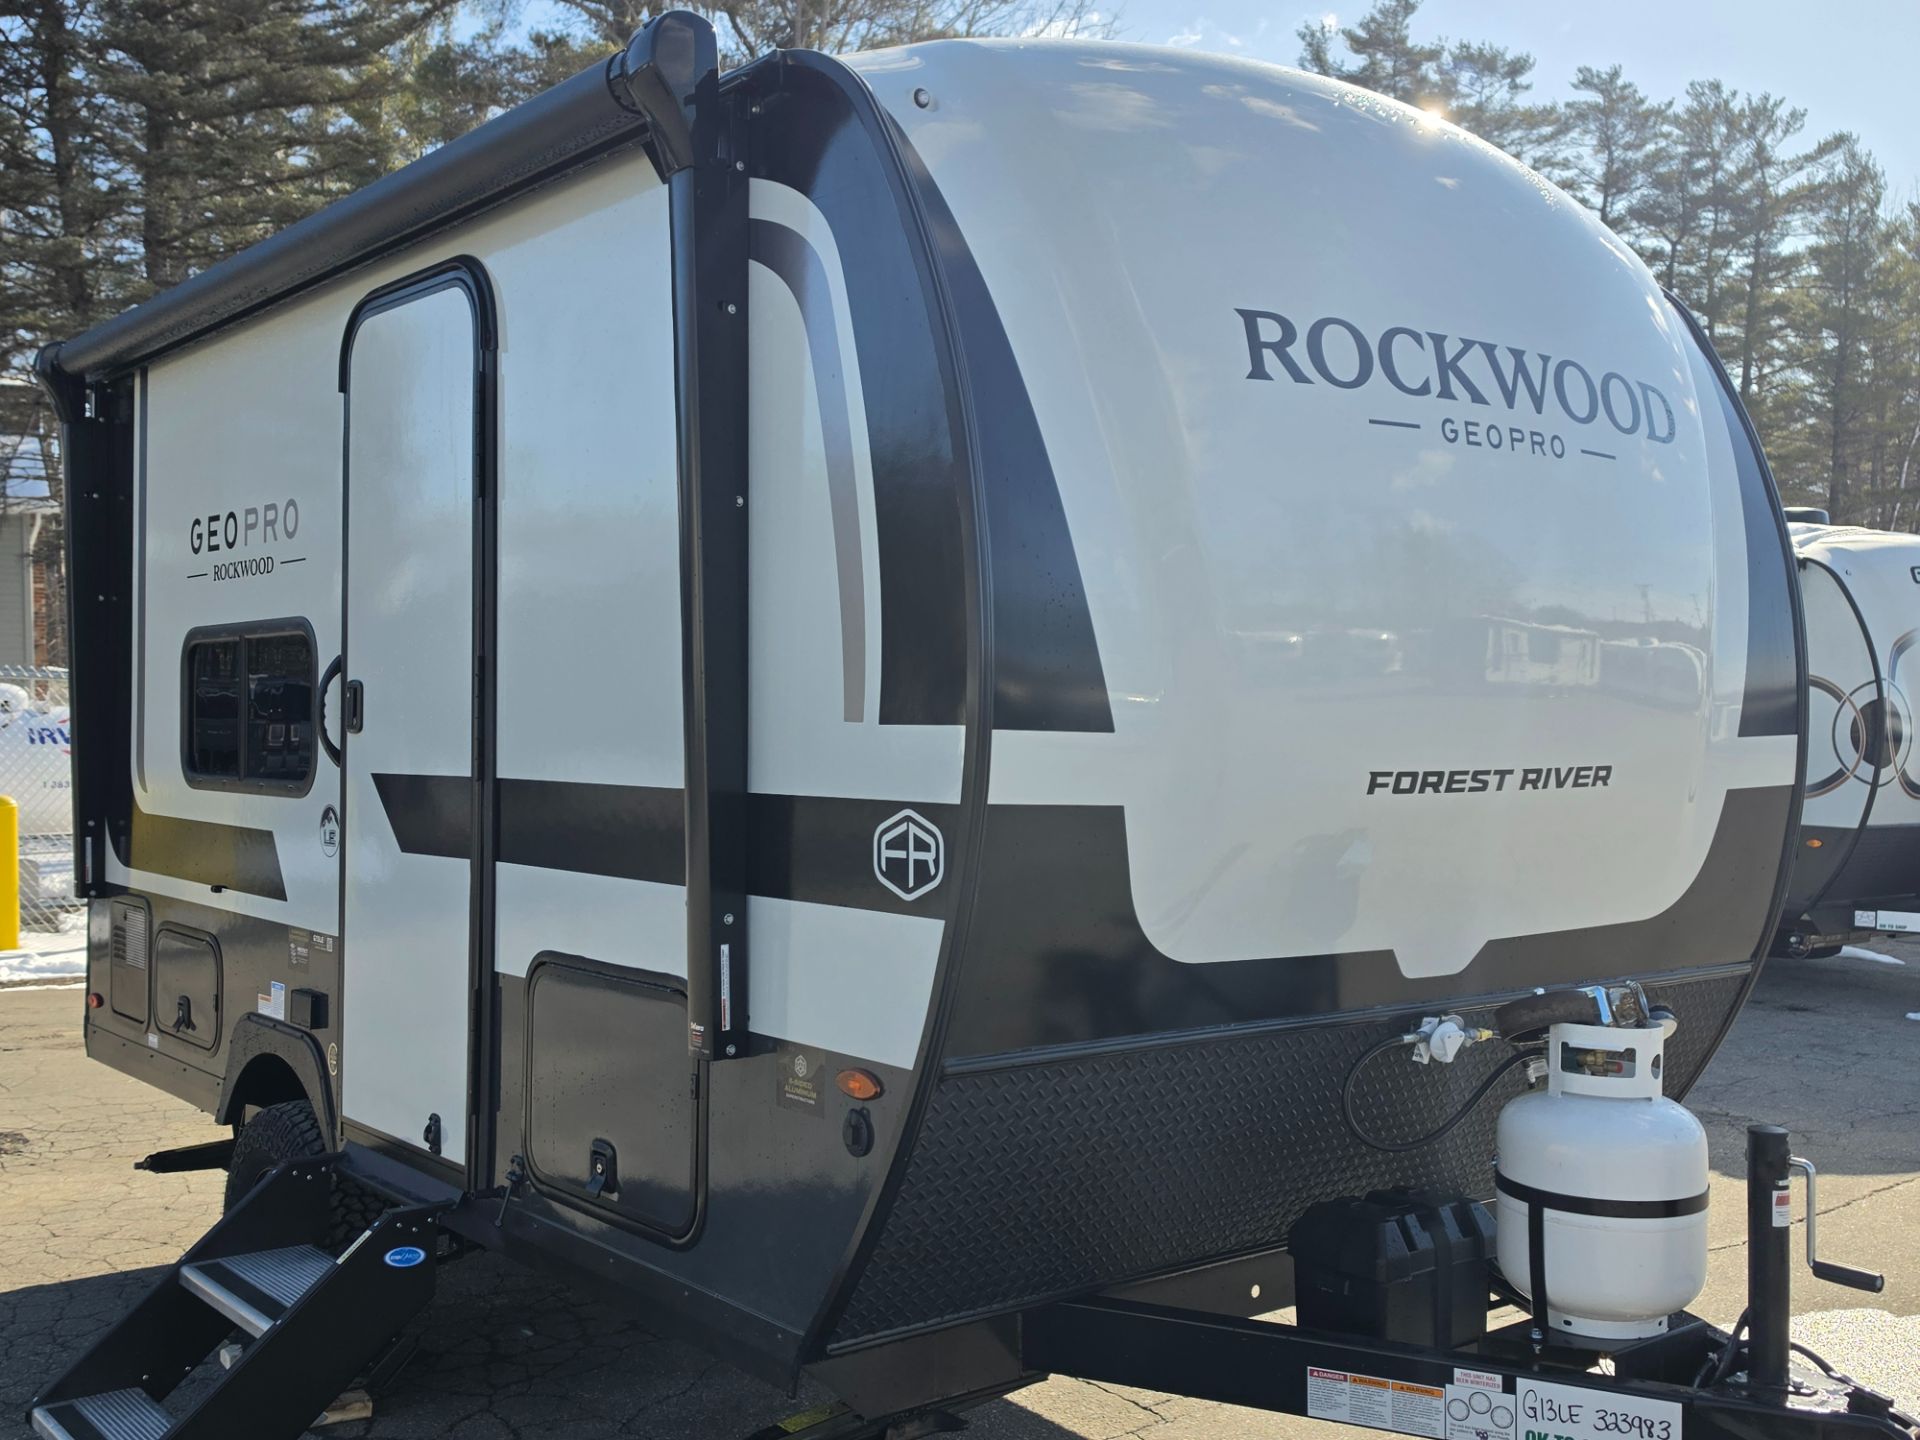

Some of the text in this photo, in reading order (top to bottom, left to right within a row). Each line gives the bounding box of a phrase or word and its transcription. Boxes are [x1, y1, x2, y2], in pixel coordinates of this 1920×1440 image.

[1233, 308, 1676, 444] ROCKWOOD
[1441, 417, 1565, 459] GEOPRO
[213, 556, 275, 581] ROCKWOOD
[1366, 765, 1613, 795] FOREST RIVER
[1319, 1371, 1345, 1381] DANGER
[1358, 1378, 1388, 1389] WARNING
[1405, 1386, 1436, 1397] WARNING
